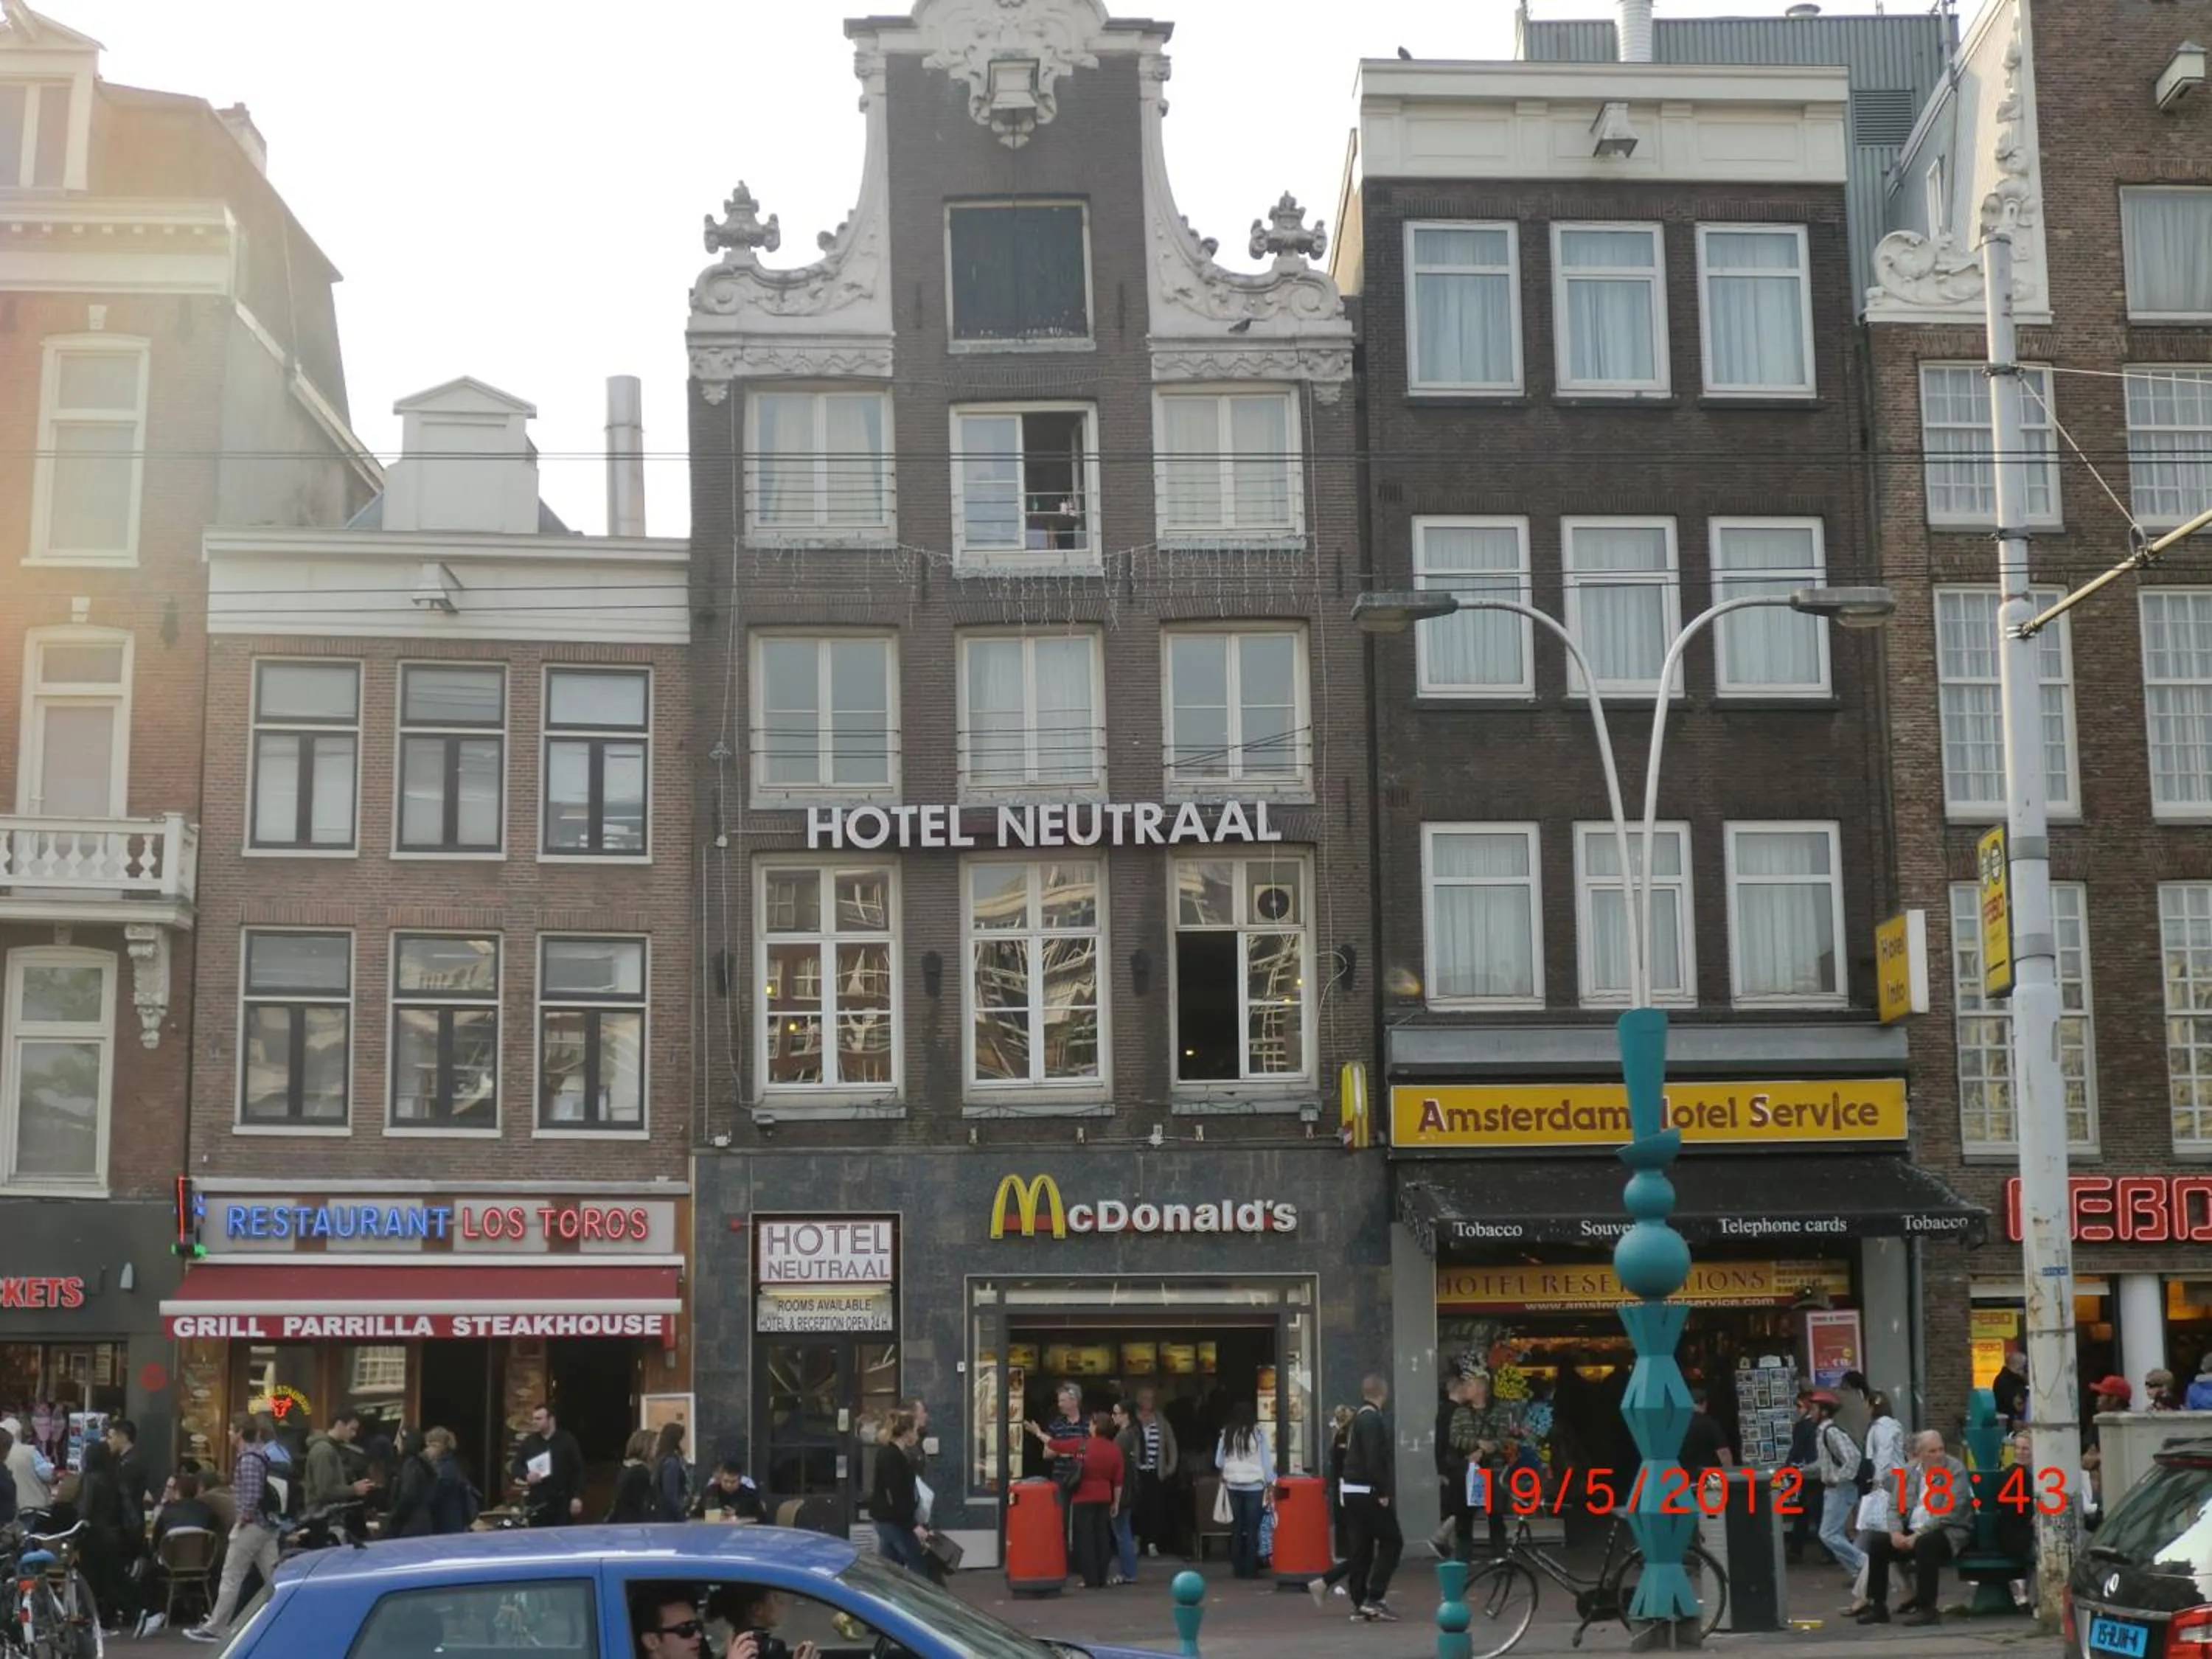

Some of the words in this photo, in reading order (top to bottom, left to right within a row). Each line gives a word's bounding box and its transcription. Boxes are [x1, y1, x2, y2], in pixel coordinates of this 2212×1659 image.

[807, 805, 974, 849] HOTEL
[998, 800, 1281, 846] NEUTRAAL
[1418, 1098, 1632, 1133] Amsterdam
[1662, 1095, 1738, 1130] otel
[1748, 1092, 1879, 1130] Service
[226, 1205, 451, 1240] RESTAURANT
[462, 1206, 526, 1239] LOS
[538, 1206, 649, 1240] TOROS
[1453, 1221, 1523, 1237] Tobacco
[1581, 1220, 1636, 1237] Souve
[1719, 1217, 1799, 1237] Telephone
[1804, 1217, 1848, 1233] cards
[1902, 1214, 1969, 1231] Tobacco
[768, 1224, 889, 1255] HOTEL
[768, 1259, 889, 1279] NEUTRAAL
[0, 1276, 84, 1307] KETS
[778, 1299, 814, 1312] ROOMS
[817, 1298, 872, 1312] AVAILABLE
[173, 1317, 265, 1338] GRILL
[283, 1316, 435, 1338] PARRILLA
[451, 1315, 662, 1336] STEAKHOUSE
[759, 1316, 789, 1330] HOTEL
